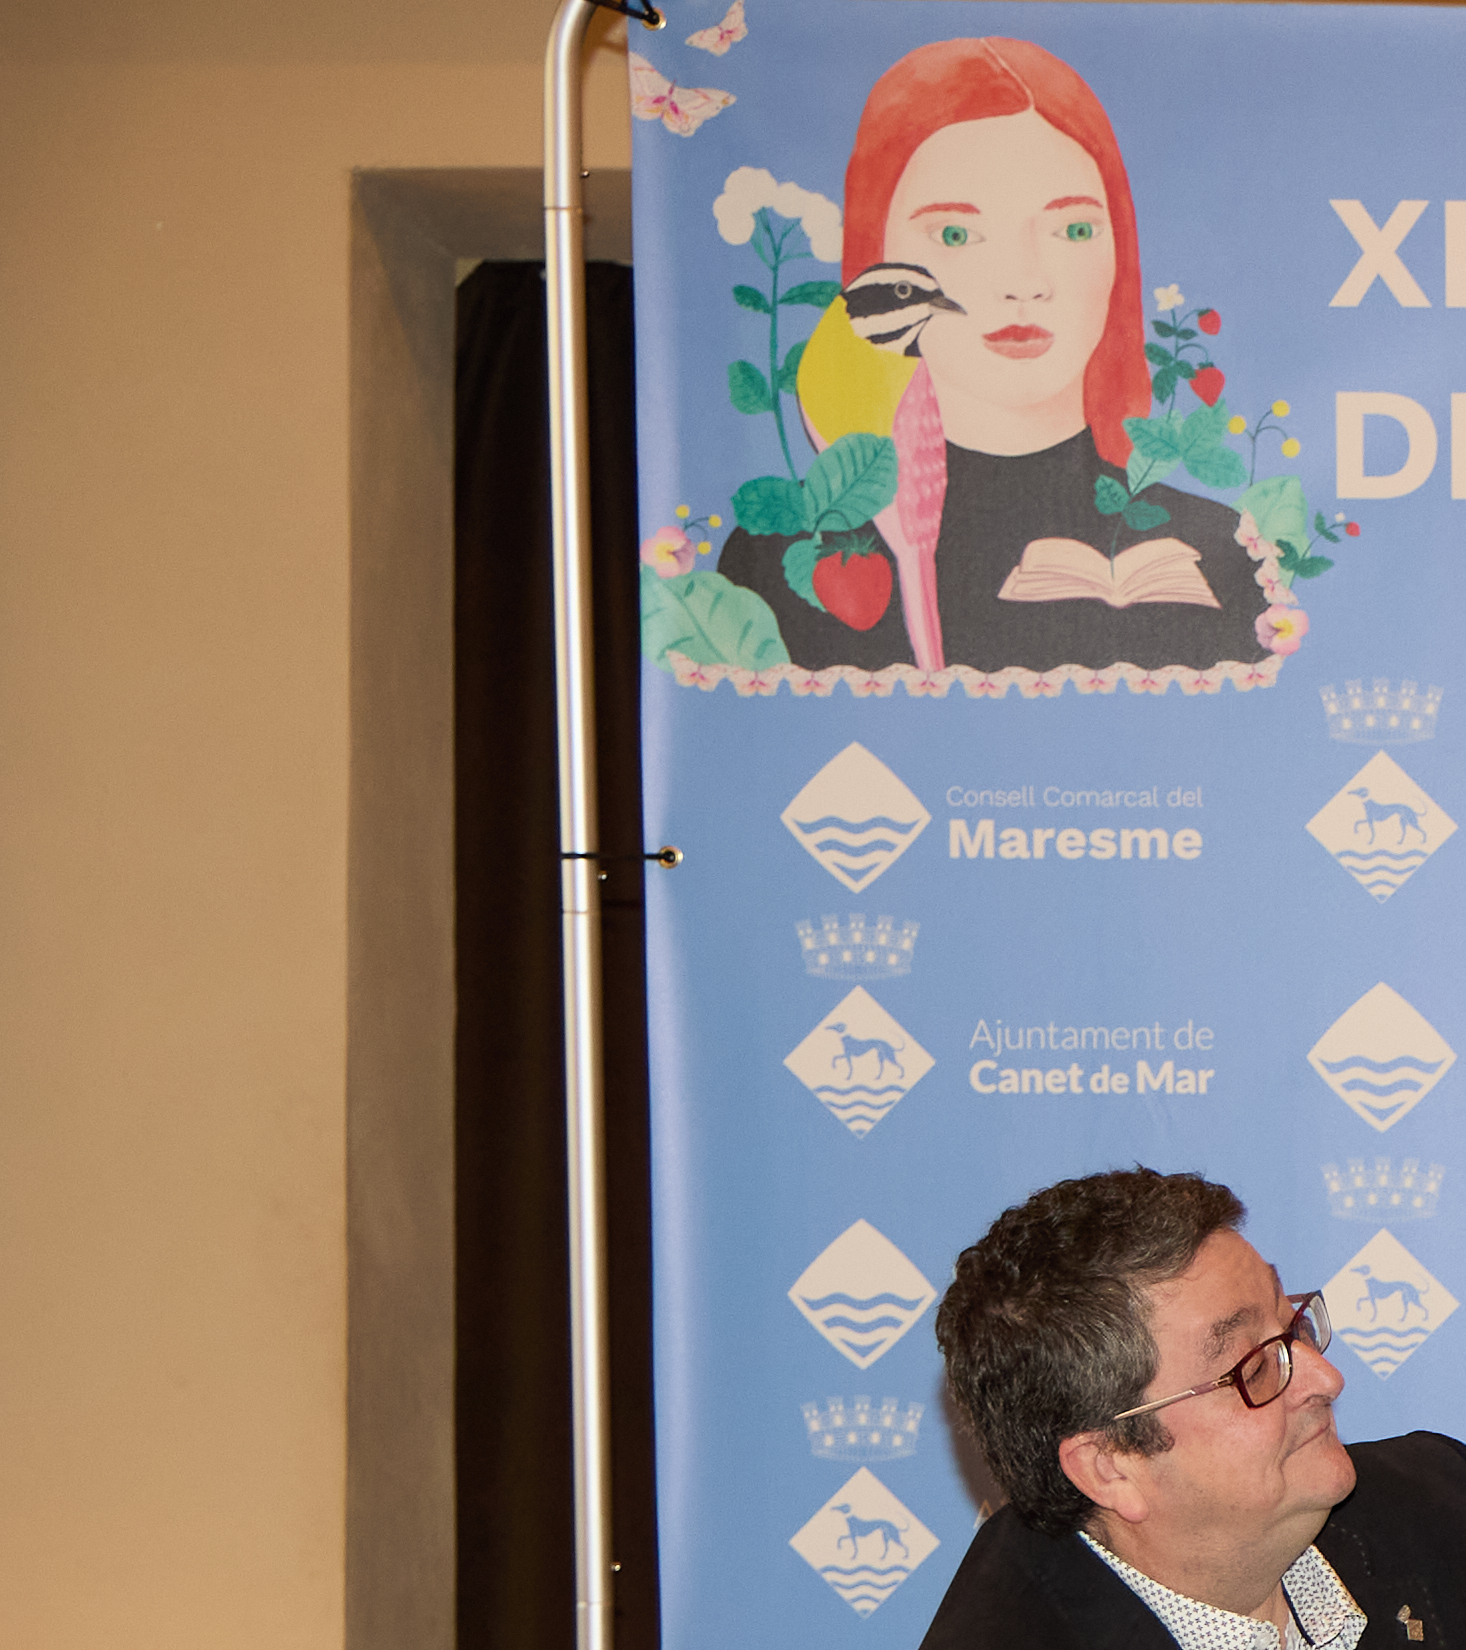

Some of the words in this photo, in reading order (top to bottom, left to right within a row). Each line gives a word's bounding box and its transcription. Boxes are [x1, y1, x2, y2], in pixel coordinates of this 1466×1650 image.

[946, 785, 1036, 807] Consell
[1043, 786, 1159, 808] Comarcal
[1166, 786, 1204, 808] del
[949, 818, 1203, 860] Maresme
